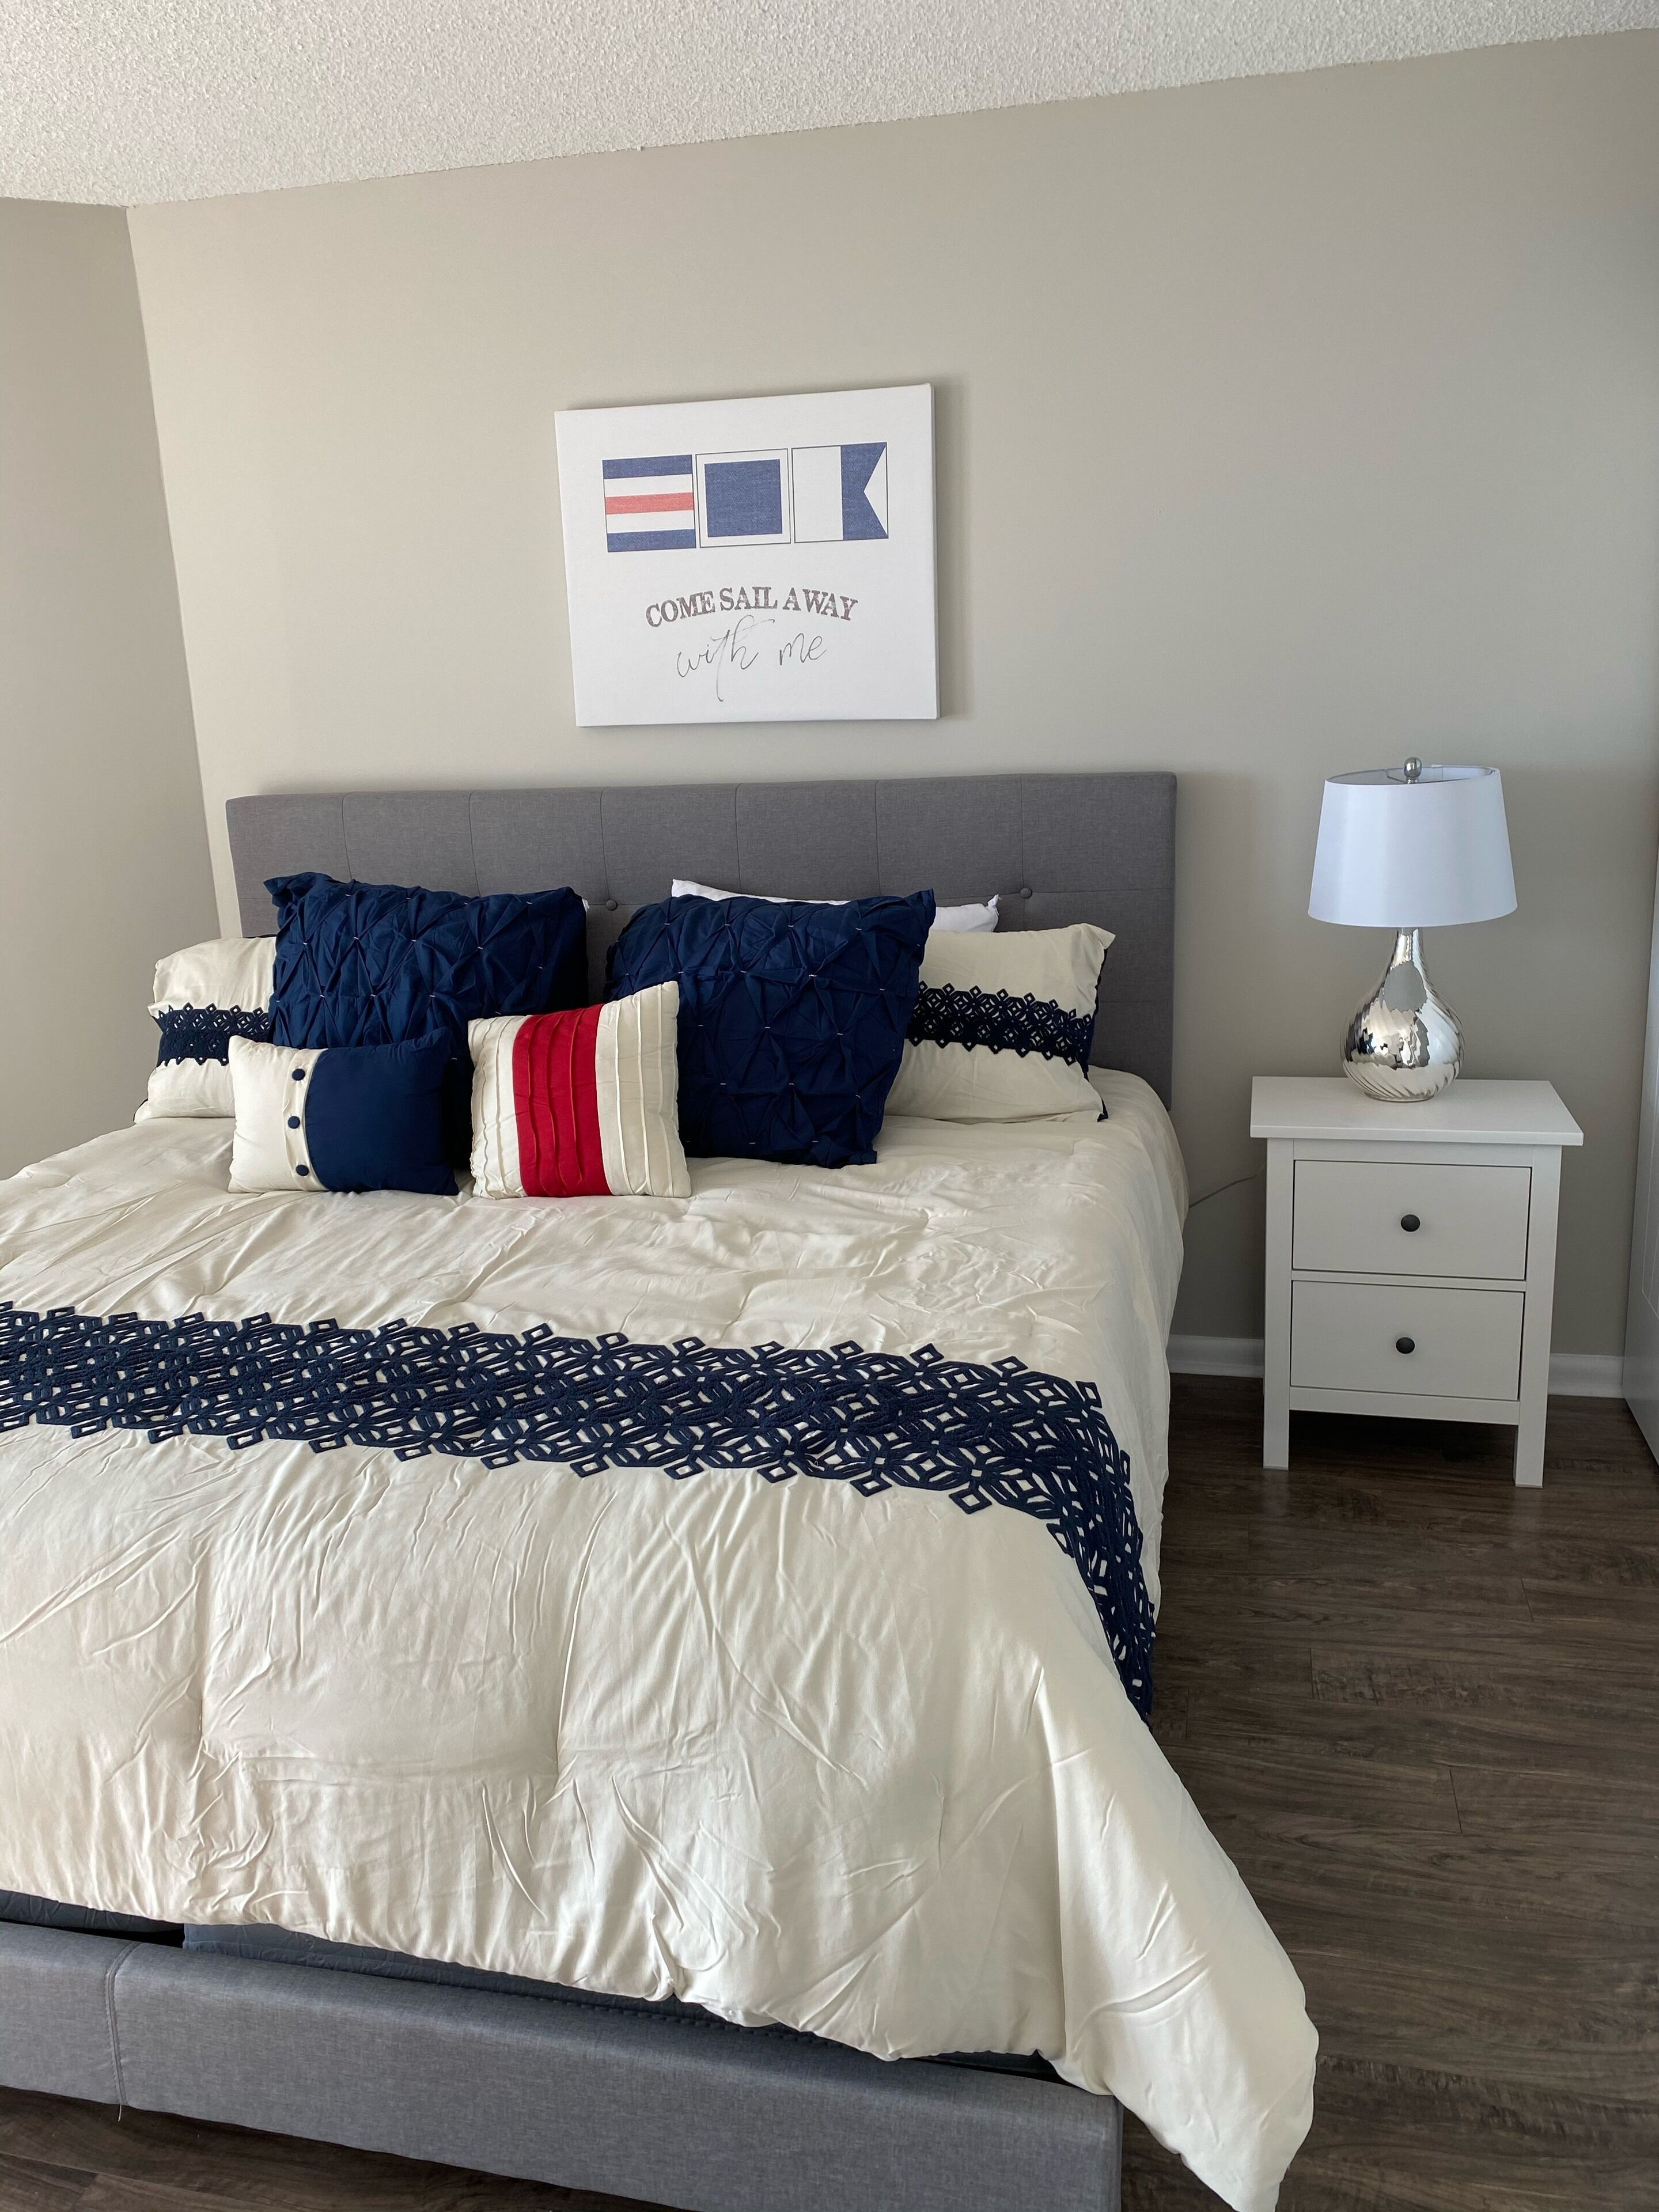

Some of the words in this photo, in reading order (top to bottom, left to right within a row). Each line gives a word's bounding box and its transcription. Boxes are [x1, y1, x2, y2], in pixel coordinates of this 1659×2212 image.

[645, 590, 716, 628] COME
[719, 586, 778, 611] SAIL
[676, 614, 775, 702] with
[779, 632, 827, 666] me
